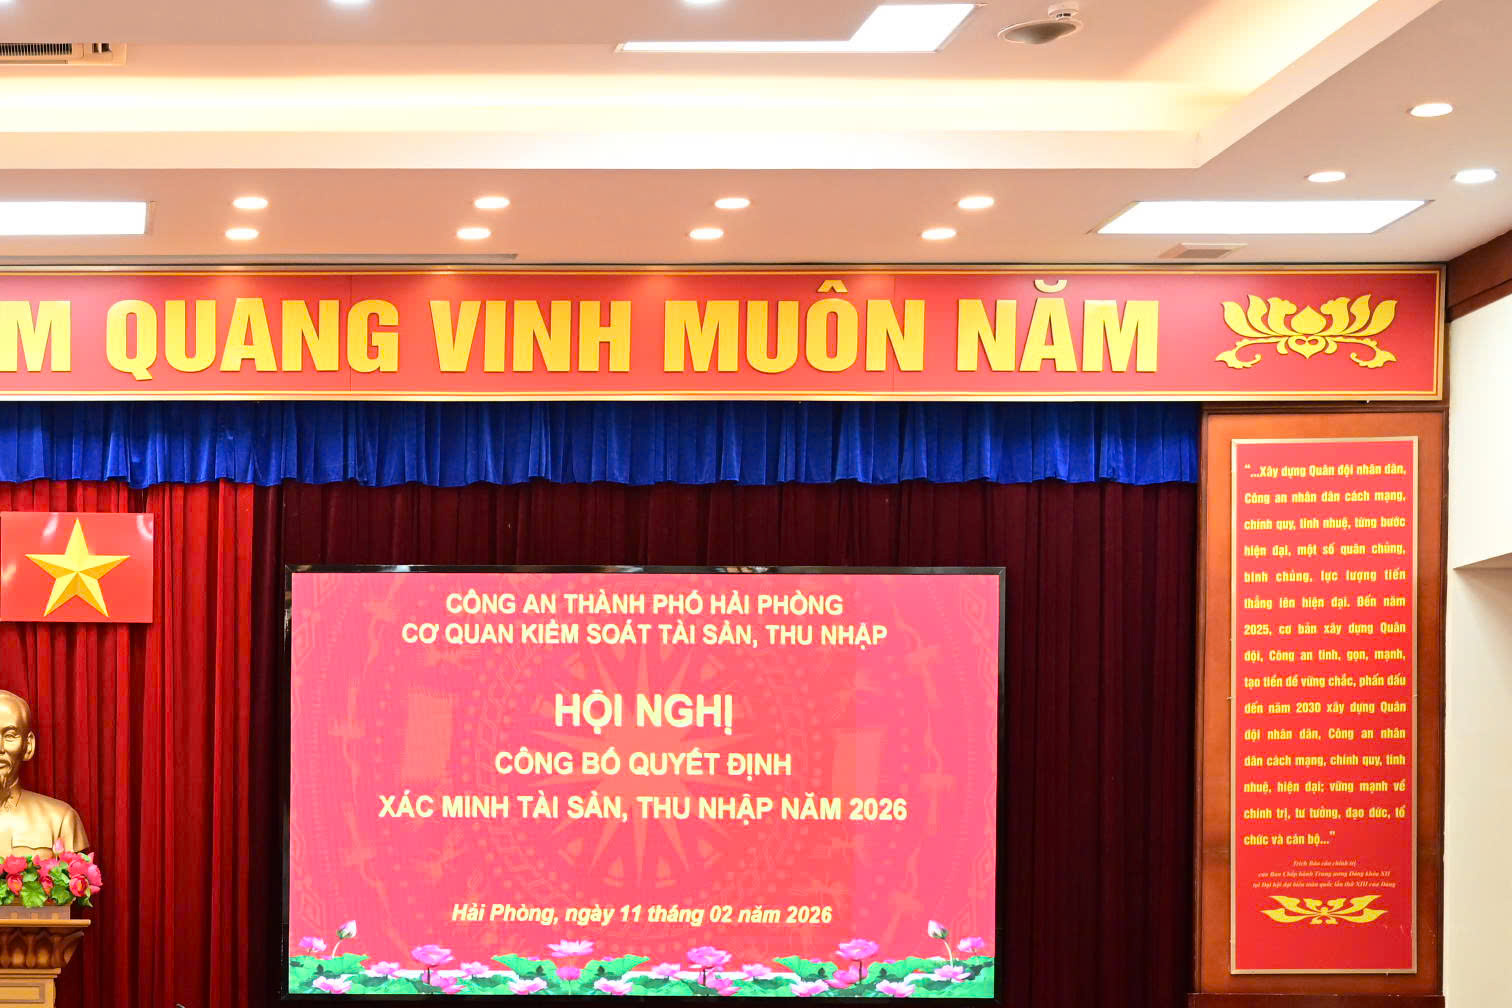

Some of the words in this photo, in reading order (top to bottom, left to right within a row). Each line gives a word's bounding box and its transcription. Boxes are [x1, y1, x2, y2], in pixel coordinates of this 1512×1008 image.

[105, 298, 399, 381] QUANG
[430, 299, 632, 373] VINH
[664, 280, 925, 373] MUÔN
[956, 279, 1159, 373] NĂM
[446, 589, 516, 614] CÔNG
[523, 594, 556, 614] AN
[564, 589, 644, 614] THÀNH
[653, 590, 703, 614] PHỐ
[711, 590, 749, 614] HẢI
[758, 590, 843, 615] PHÒNG
[402, 623, 439, 643] CƠ
[445, 623, 513, 644] QUAN
[587, 619, 652, 644] SOÁT
[658, 619, 695, 644] TÀI
[765, 625, 812, 645] THU
[821, 623, 887, 650] NHẬP
[555, 689, 622, 734] HỘI
[637, 693, 732, 735] NGHỊ
[495, 747, 573, 775] CÔNG
[582, 747, 621, 775] BỐ
[629, 747, 720, 776] QUYẾT
[727, 753, 791, 781] ĐỊNH
[379, 790, 434, 818] XÁC
[442, 795, 509, 818] MINH
[517, 790, 558, 818] TÀI
[636, 796, 690, 819] THU
[699, 794, 773, 825] NHẬP
[782, 792, 841, 820] NĂM
[849, 798, 907, 820] 2026
[452, 903, 485, 921] Hải
[490, 904, 558, 925] Phòng,
[565, 904, 615, 926] ngày
[620, 905, 641, 922] 11
[648, 904, 705, 927] tháng
[710, 905, 732, 923] 02
[737, 905, 781, 923] năm
[786, 906, 832, 923] 2026
